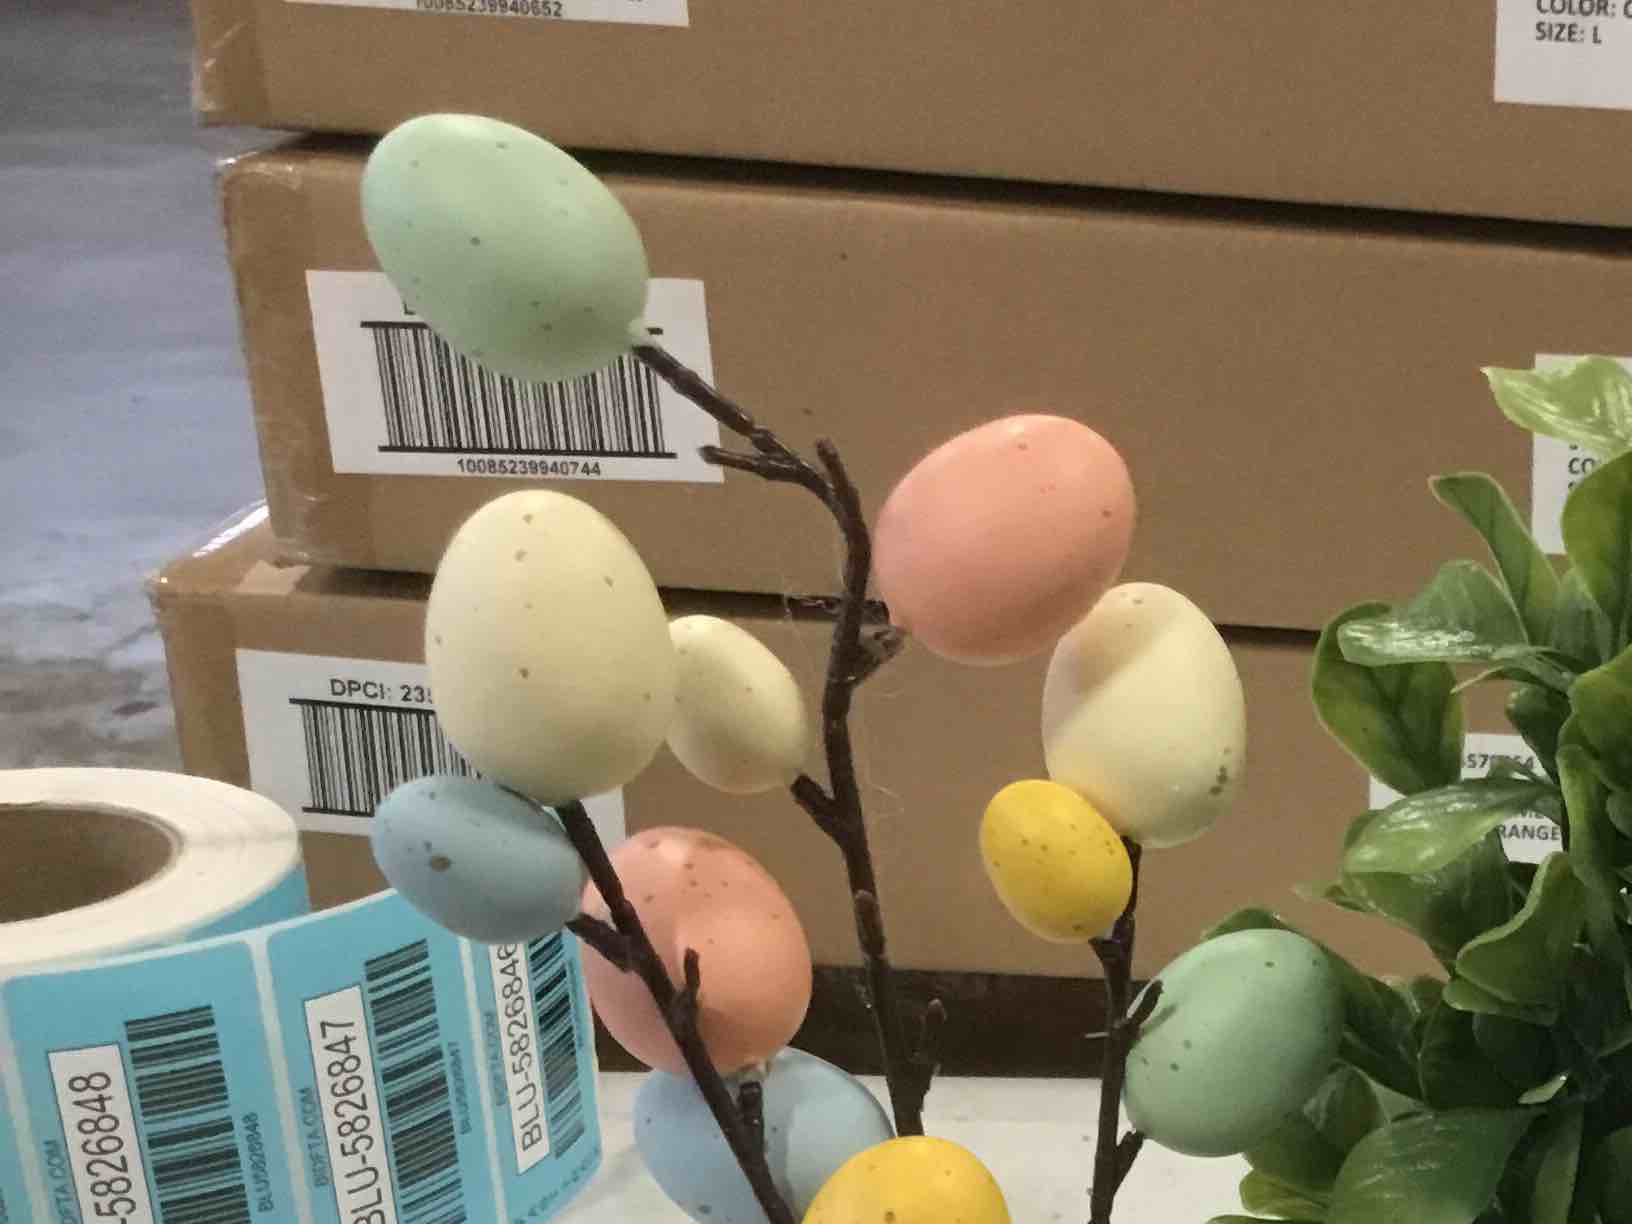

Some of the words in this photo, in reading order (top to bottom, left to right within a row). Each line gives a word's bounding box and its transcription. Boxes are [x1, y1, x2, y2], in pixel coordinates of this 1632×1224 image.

[1536, 0, 1616, 17] COLOR:
[1535, 22, 1585, 43] SIZE:
[1592, 26, 1603, 44] L
[457, 457, 601, 476] 10085239940744
[329, 677, 393, 700] DPCI:
